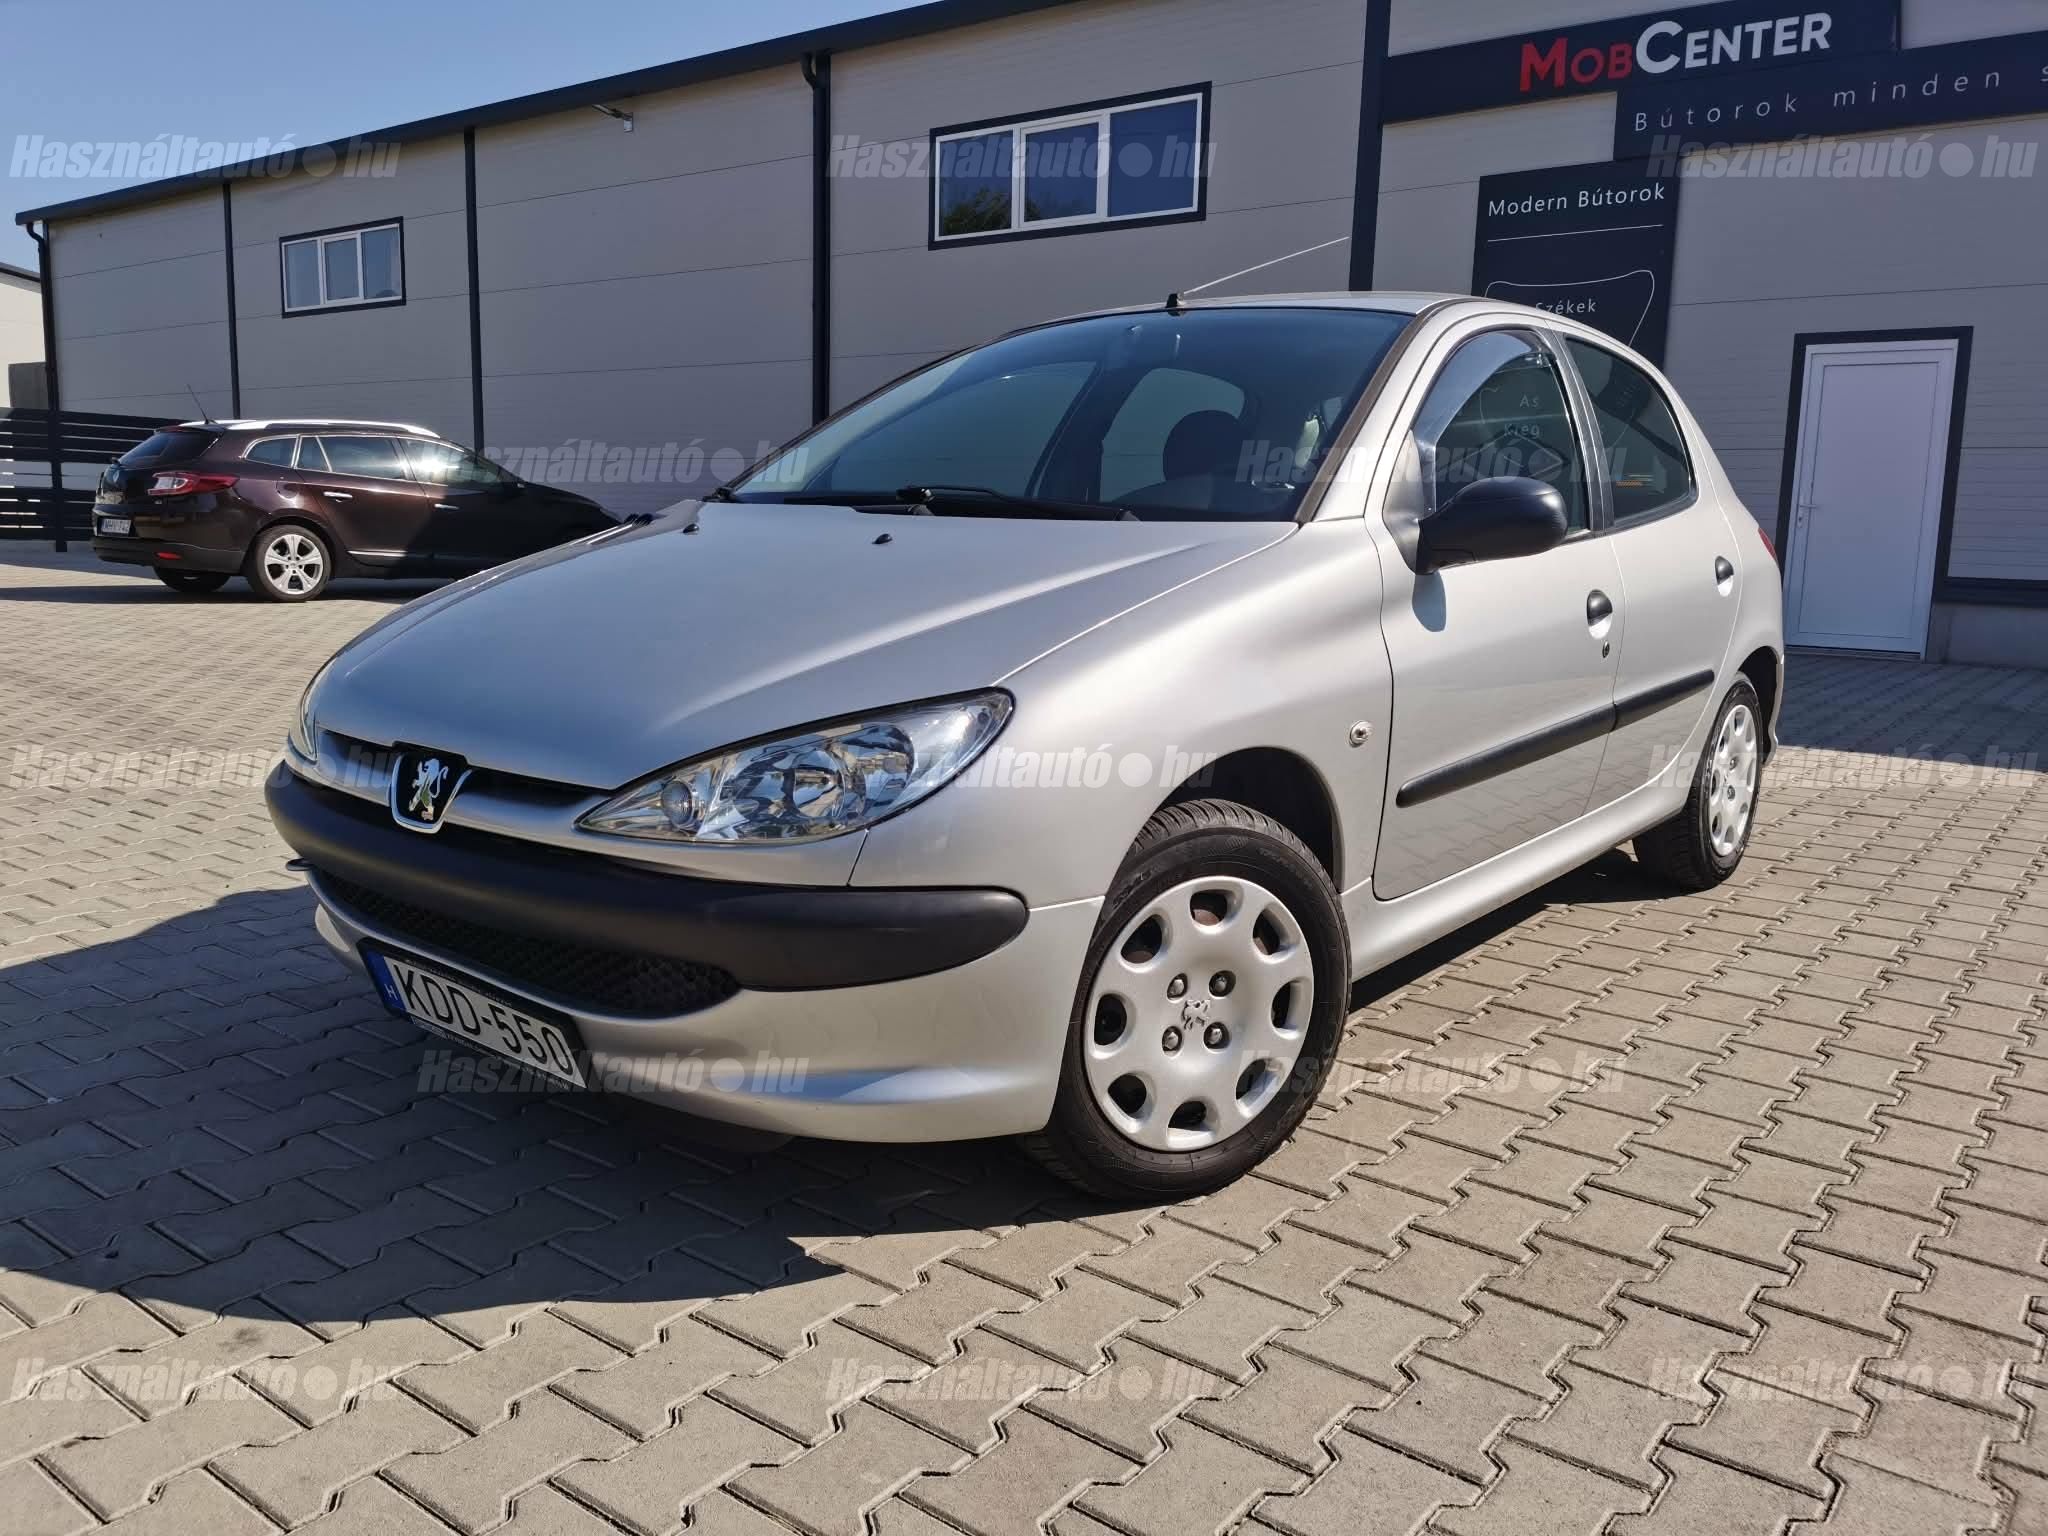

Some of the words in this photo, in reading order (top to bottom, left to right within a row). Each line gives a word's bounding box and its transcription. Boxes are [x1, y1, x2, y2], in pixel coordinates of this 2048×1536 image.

[1635, 93, 1797, 131] Bútorok
[1833, 71, 2001, 107] minden
[1488, 196, 1567, 217] Modern
[1578, 182, 1664, 208] Bútorok
[385, 983, 399, 1001] H
[393, 964, 574, 1076] KDD-550
